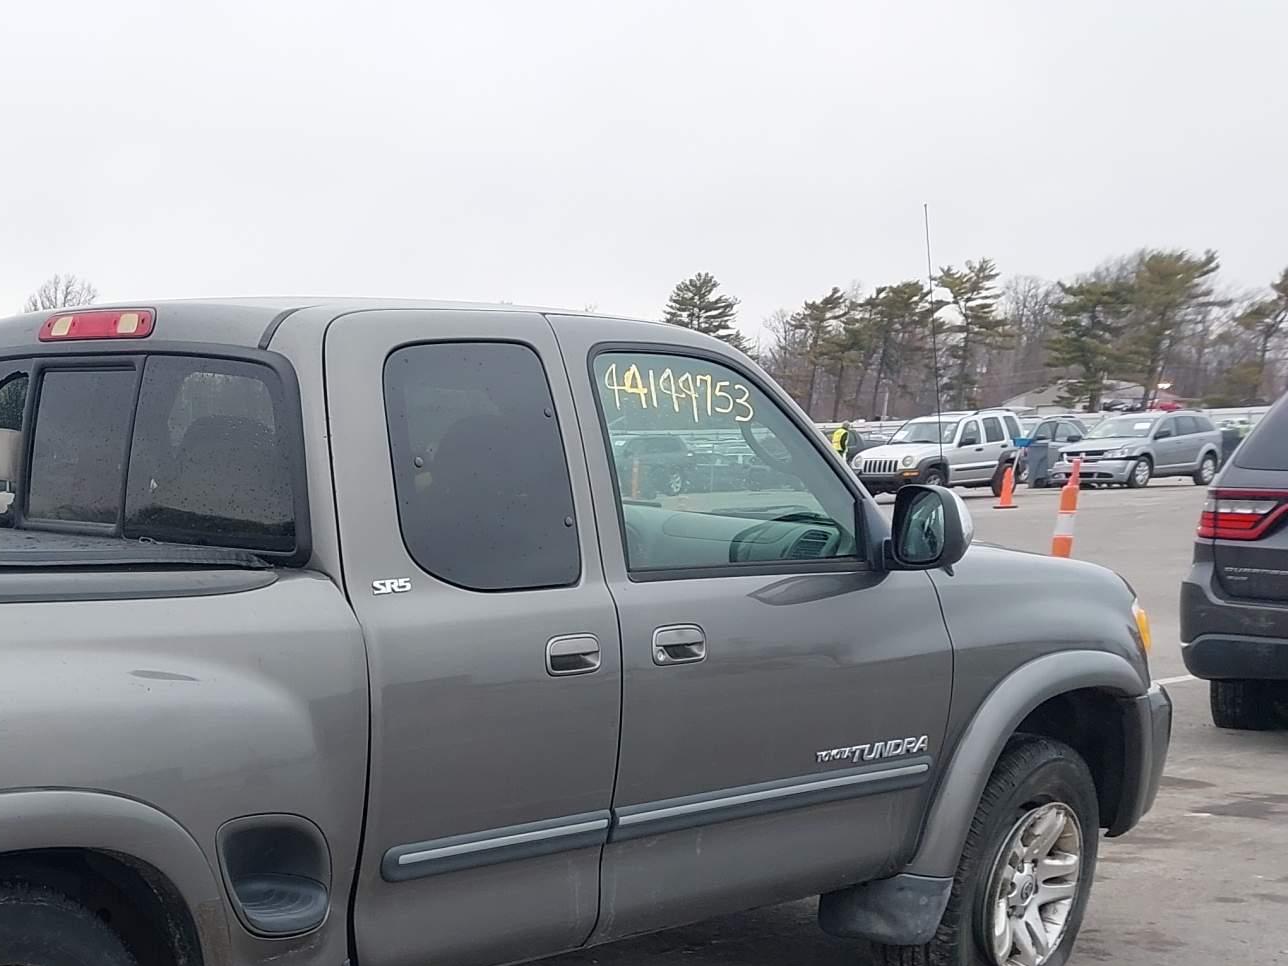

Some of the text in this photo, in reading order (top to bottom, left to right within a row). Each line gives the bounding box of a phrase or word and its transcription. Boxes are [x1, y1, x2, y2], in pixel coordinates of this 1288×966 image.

[604, 362, 755, 423] 44144753
[372, 577, 412, 594] SR5
[816, 735, 929, 763] TOYOTA TUNDRA
